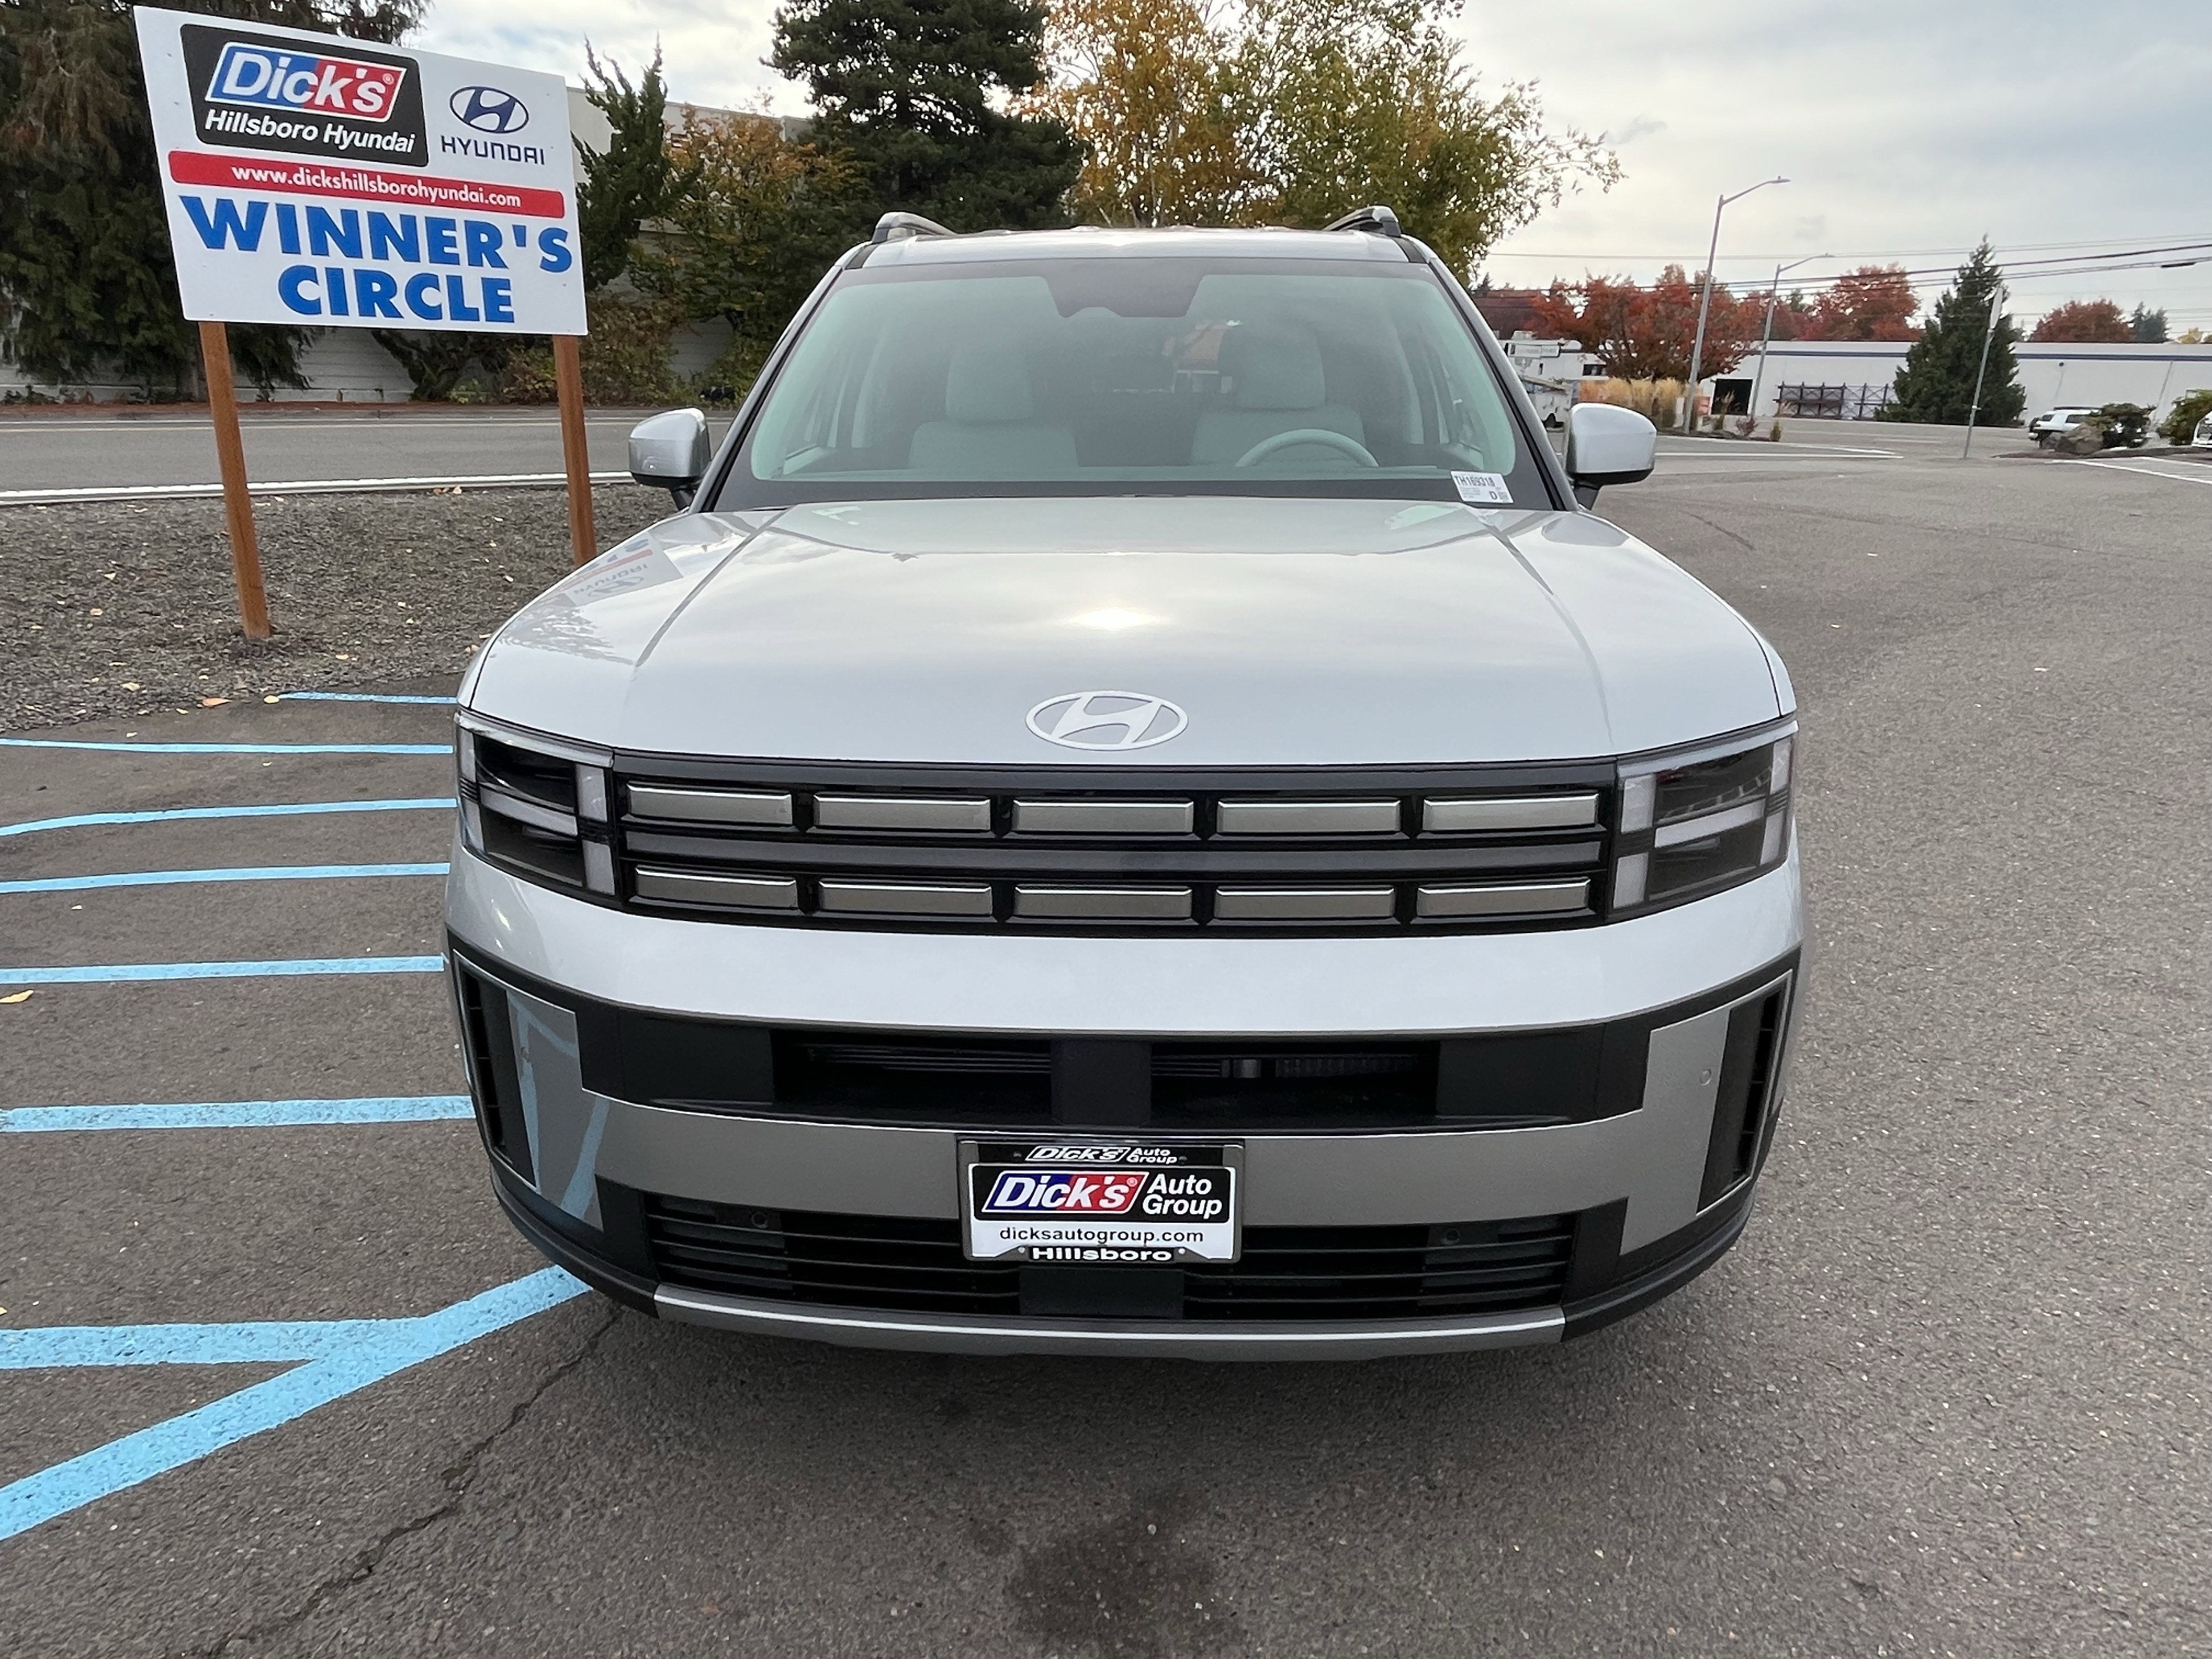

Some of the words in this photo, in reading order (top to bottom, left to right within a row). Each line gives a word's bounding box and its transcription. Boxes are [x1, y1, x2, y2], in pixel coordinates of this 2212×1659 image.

[205, 109, 318, 140] Hillsboro
[323, 123, 416, 154] Hyundai
[441, 135, 545, 165] HYUNDAI
[232, 165, 521, 208] www.dickshillsborohyundai.com
[179, 195, 573, 273] WINNER'S
[278, 265, 515, 324] CIRCLE
[1126, 1155, 1177, 1164] Group
[1127, 1148, 1171, 1156] Auto
[1147, 1173, 1212, 1195] Auto
[1142, 1195, 1222, 1219] Group
[1000, 1227, 1204, 1244] dicksautogroup.com
[1032, 1248, 1172, 1261] Hillsboro
